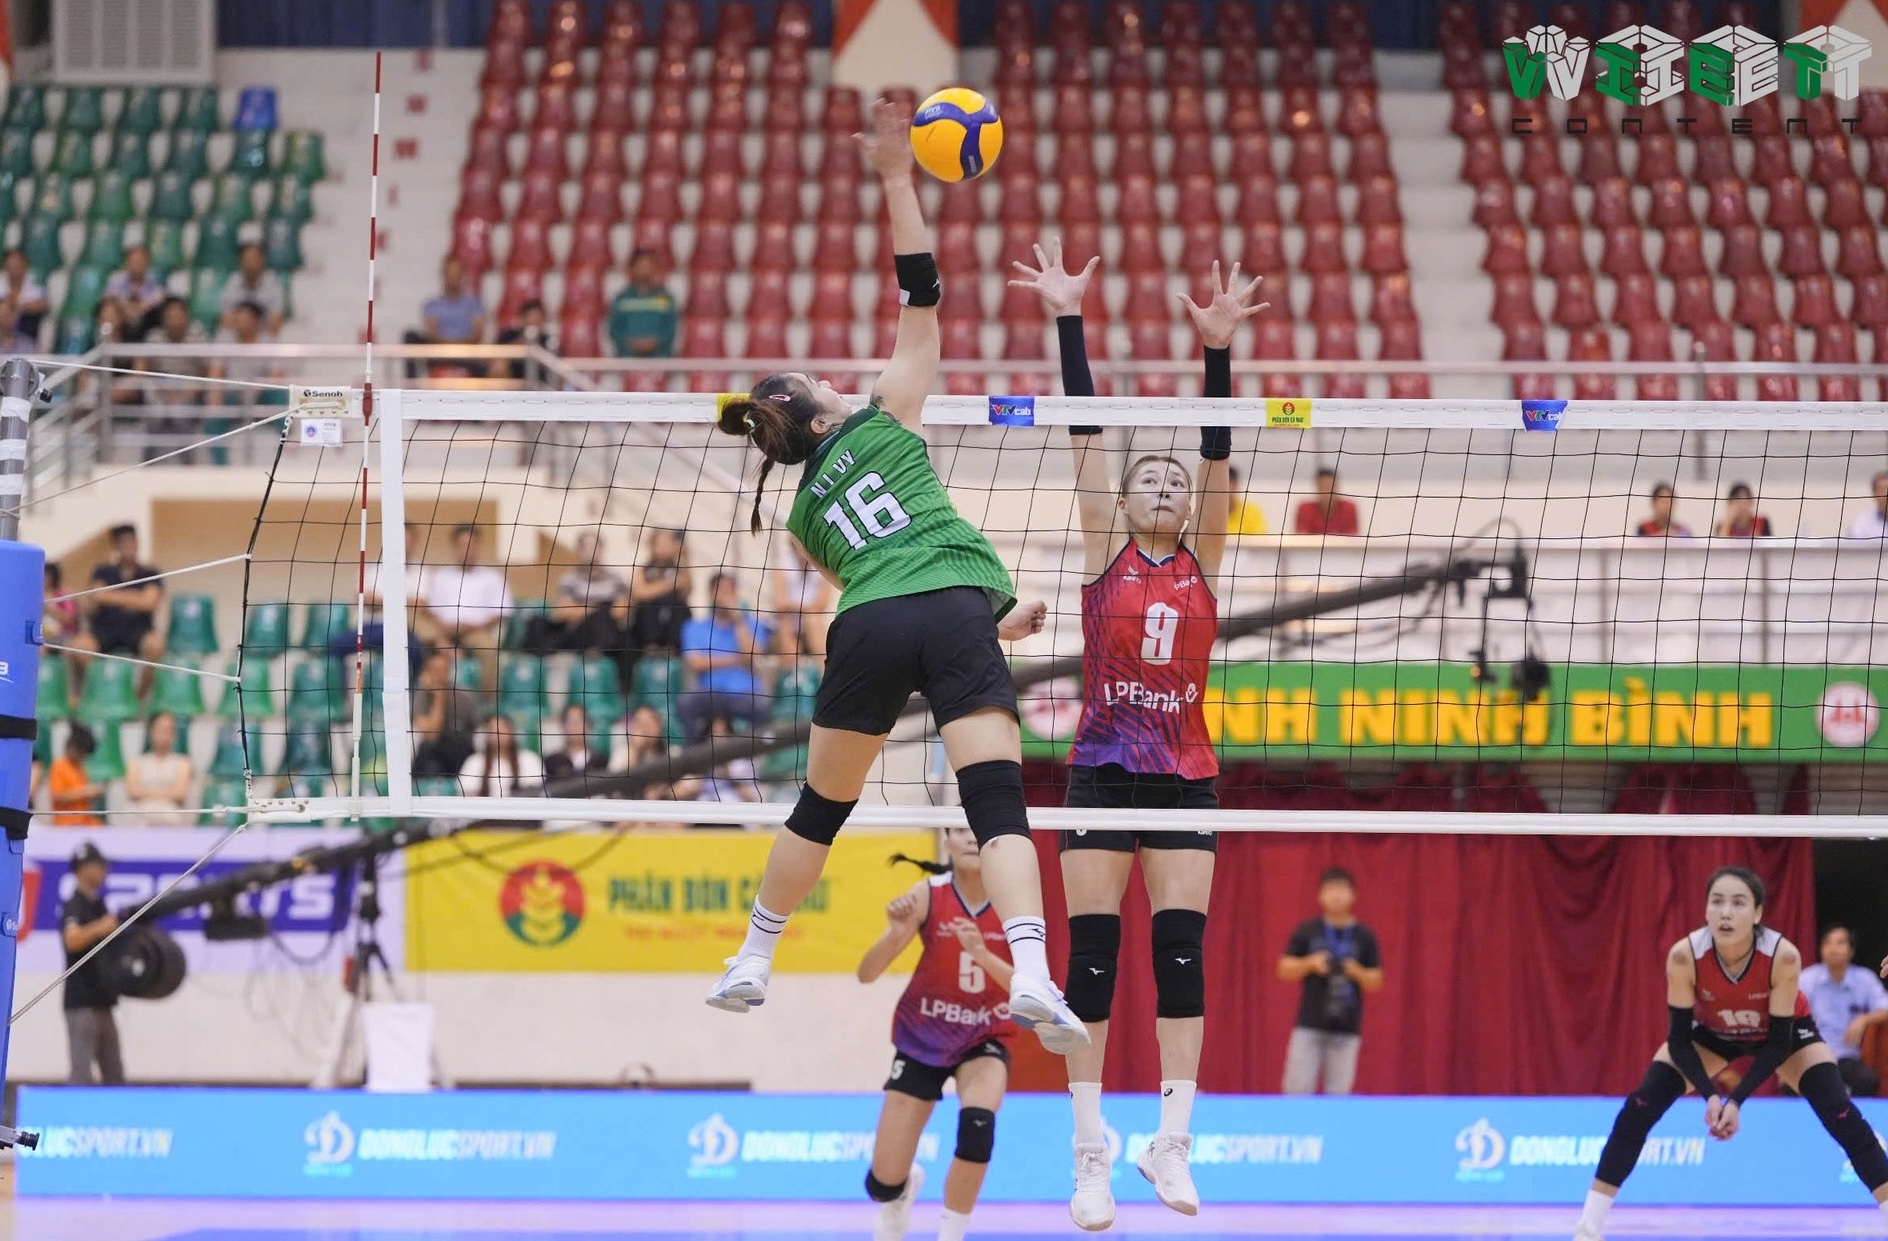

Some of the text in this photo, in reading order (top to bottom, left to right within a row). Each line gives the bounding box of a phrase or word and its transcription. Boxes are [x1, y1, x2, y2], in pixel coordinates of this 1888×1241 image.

[311, 389, 342, 398] Senoh
[992, 404, 1032, 416] VTVcab
[822, 471, 913, 550] 16
[1140, 602, 1179, 666] 9
[1104, 681, 1183, 714] LPBank
[1339, 687, 1549, 746] NINH
[1570, 677, 1773, 747] BÌNH
[958, 951, 986, 994] 5
[920, 997, 991, 1027] LPBank
